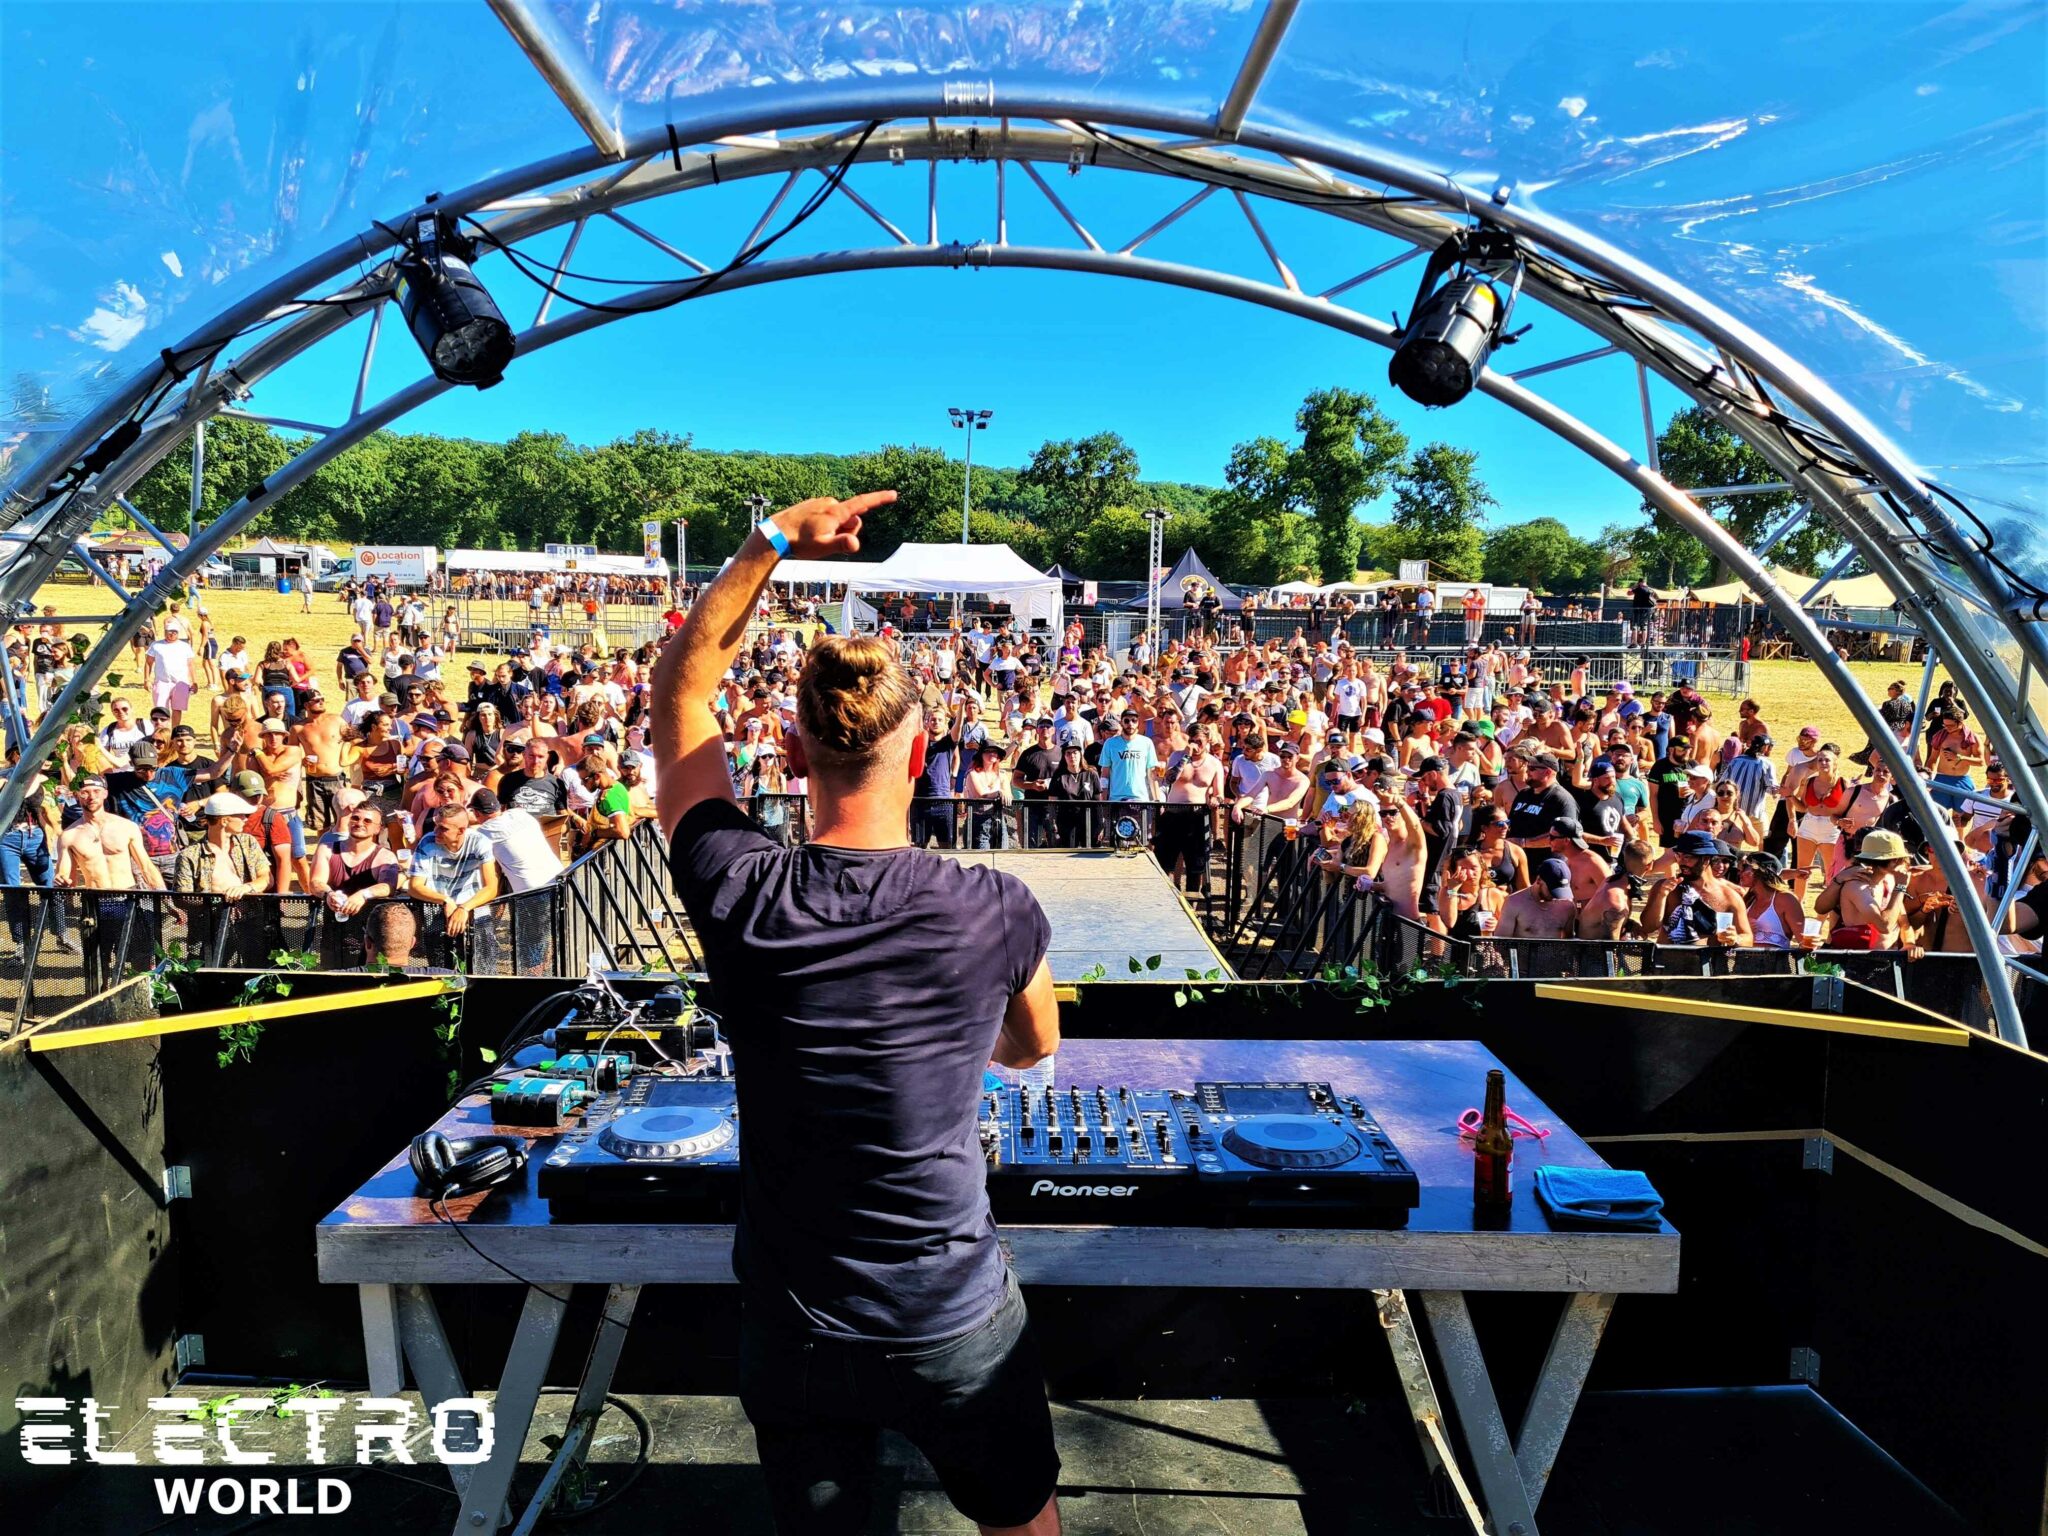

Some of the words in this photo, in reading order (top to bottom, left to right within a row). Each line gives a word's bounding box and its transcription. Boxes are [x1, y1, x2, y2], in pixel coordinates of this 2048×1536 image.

[376, 551, 420, 560] Location
[1118, 750, 1141, 760] VANS
[1030, 1179, 1139, 1197] Pioneer
